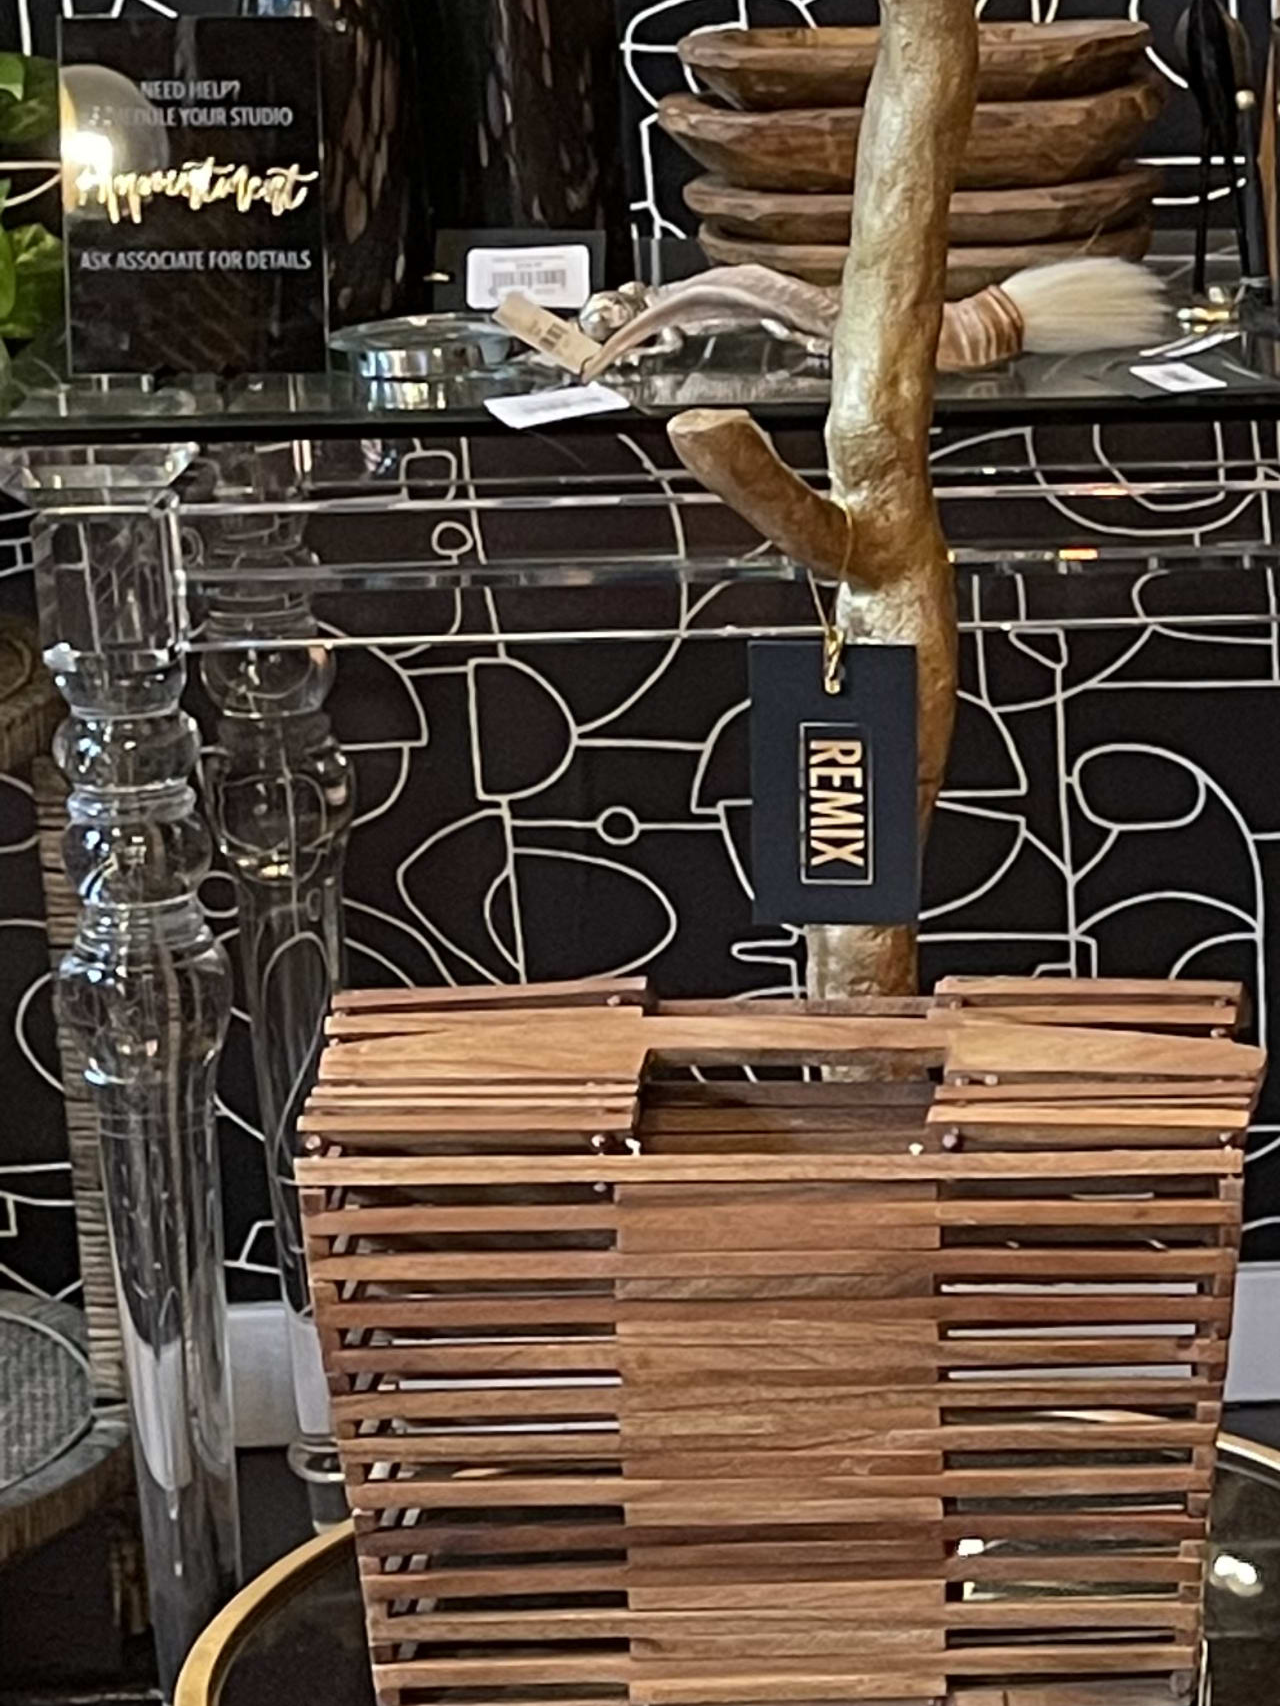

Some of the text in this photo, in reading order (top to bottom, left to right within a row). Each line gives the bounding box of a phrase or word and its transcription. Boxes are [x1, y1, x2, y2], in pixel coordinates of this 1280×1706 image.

[140, 80, 240, 101] NEED HELP?
[180, 107, 226, 127] YOUR
[230, 106, 293, 127] STUDIO
[80, 249, 312, 270] ASK ASSOCIATE FOR DETAILS
[809, 739, 866, 868] REMIX
